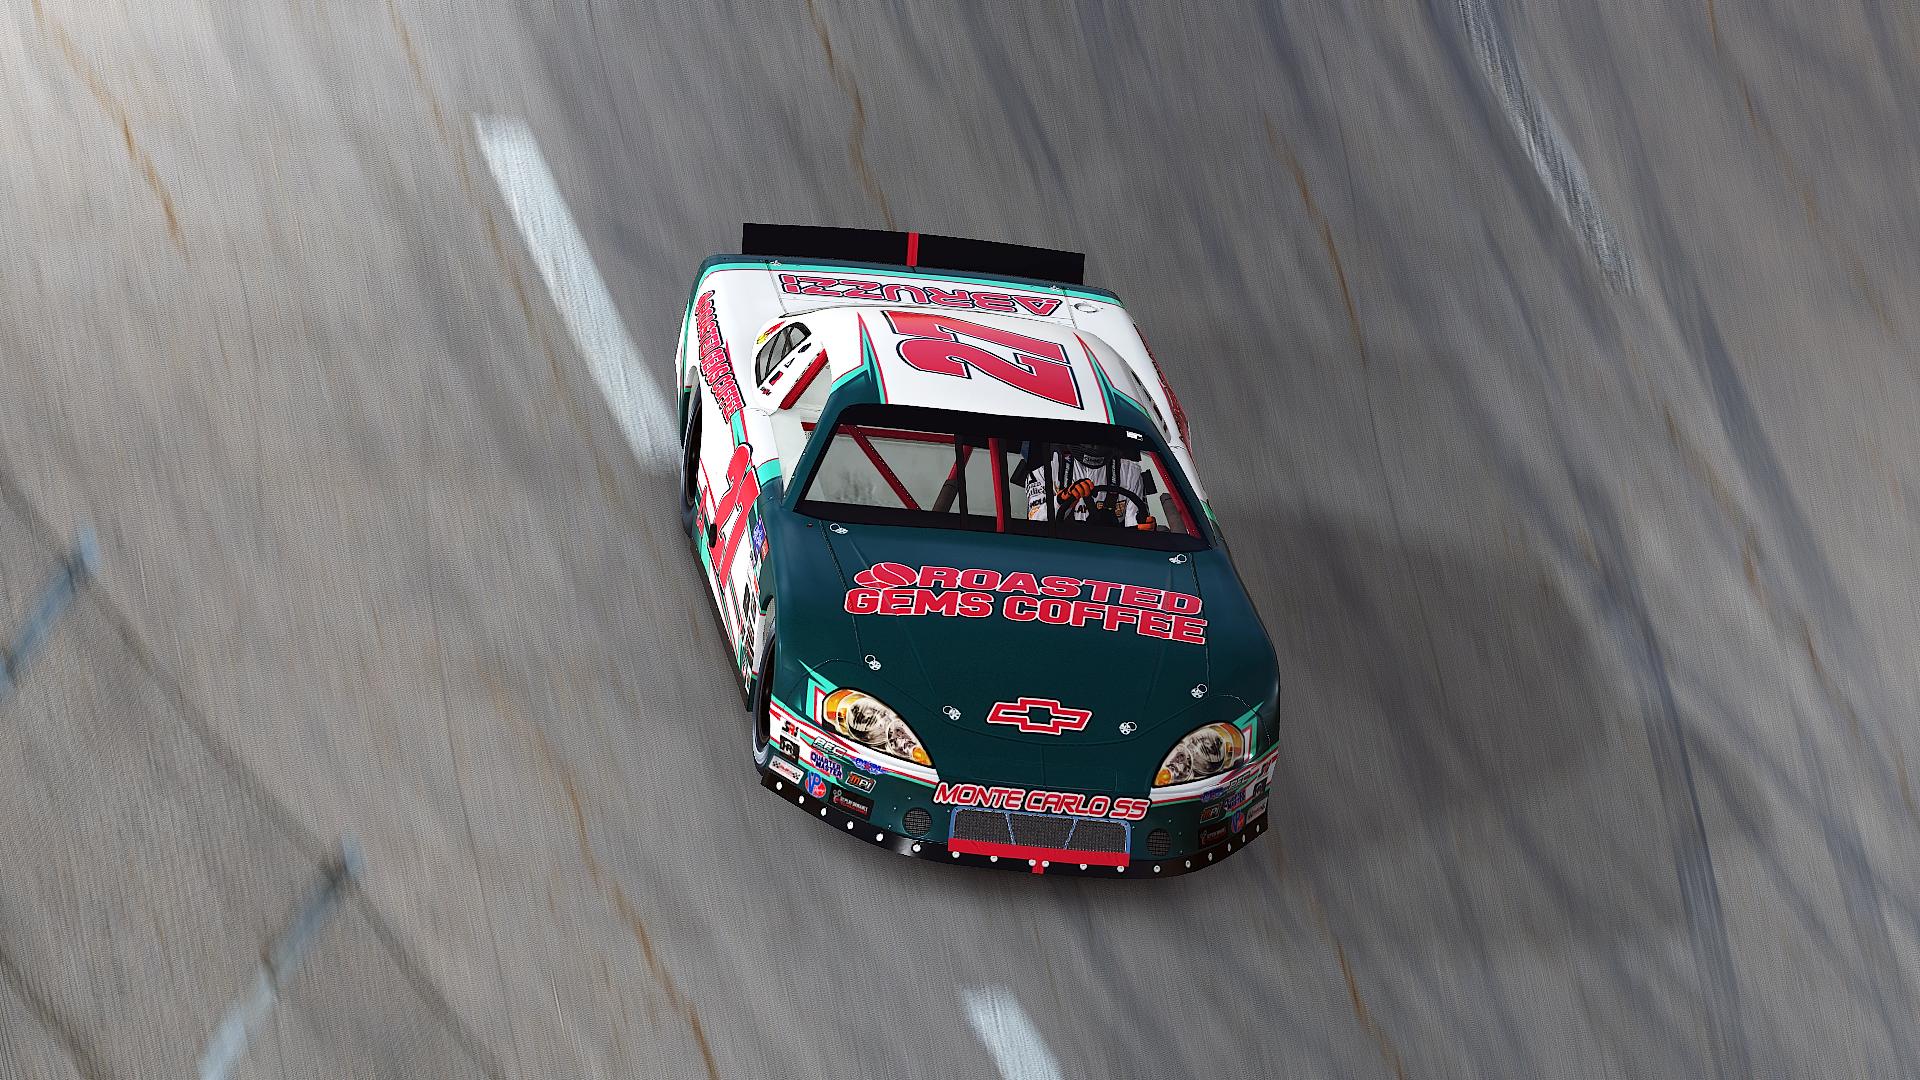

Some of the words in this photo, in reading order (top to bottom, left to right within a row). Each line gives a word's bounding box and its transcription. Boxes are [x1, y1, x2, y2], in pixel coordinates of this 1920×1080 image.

[779, 273, 1063, 316] ABRUZZI
[881, 310, 1084, 410] 27
[917, 565, 1203, 615] ROASTED
[844, 588, 994, 617] GEMS
[1002, 595, 1208, 645] COFFEE
[810, 750, 842, 771] QUARTER
[815, 759, 843, 780] MASTER
[933, 782, 1025, 810] MONTE
[1026, 789, 1110, 816] CARLO
[1108, 798, 1150, 820] SS
